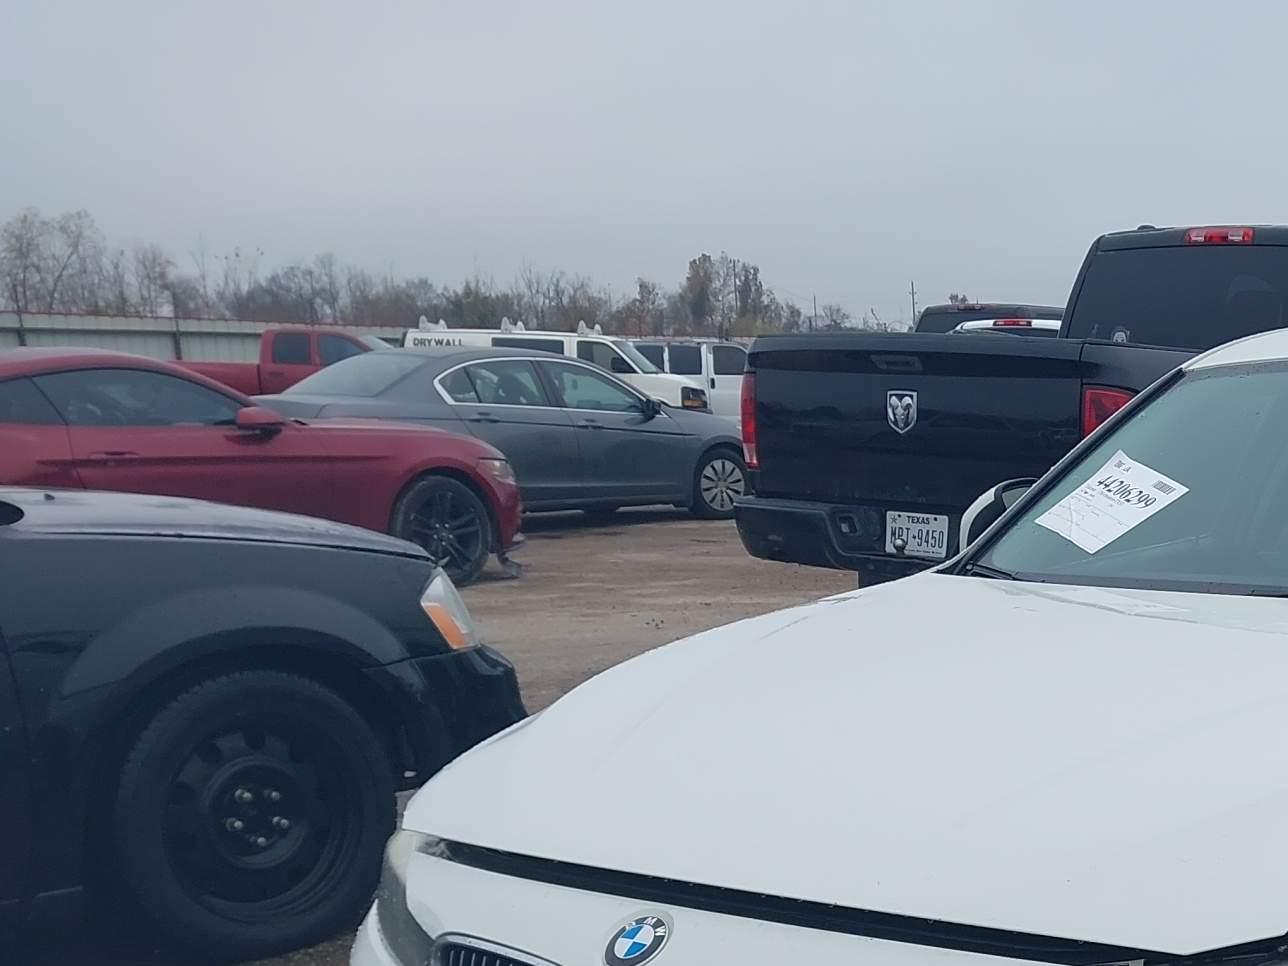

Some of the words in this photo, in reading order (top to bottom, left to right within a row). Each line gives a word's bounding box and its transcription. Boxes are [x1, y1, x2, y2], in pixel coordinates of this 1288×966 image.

[1096, 475, 1155, 508] 44206299
[906, 515, 930, 525] TEXAS
[917, 529, 944, 549] 9450
